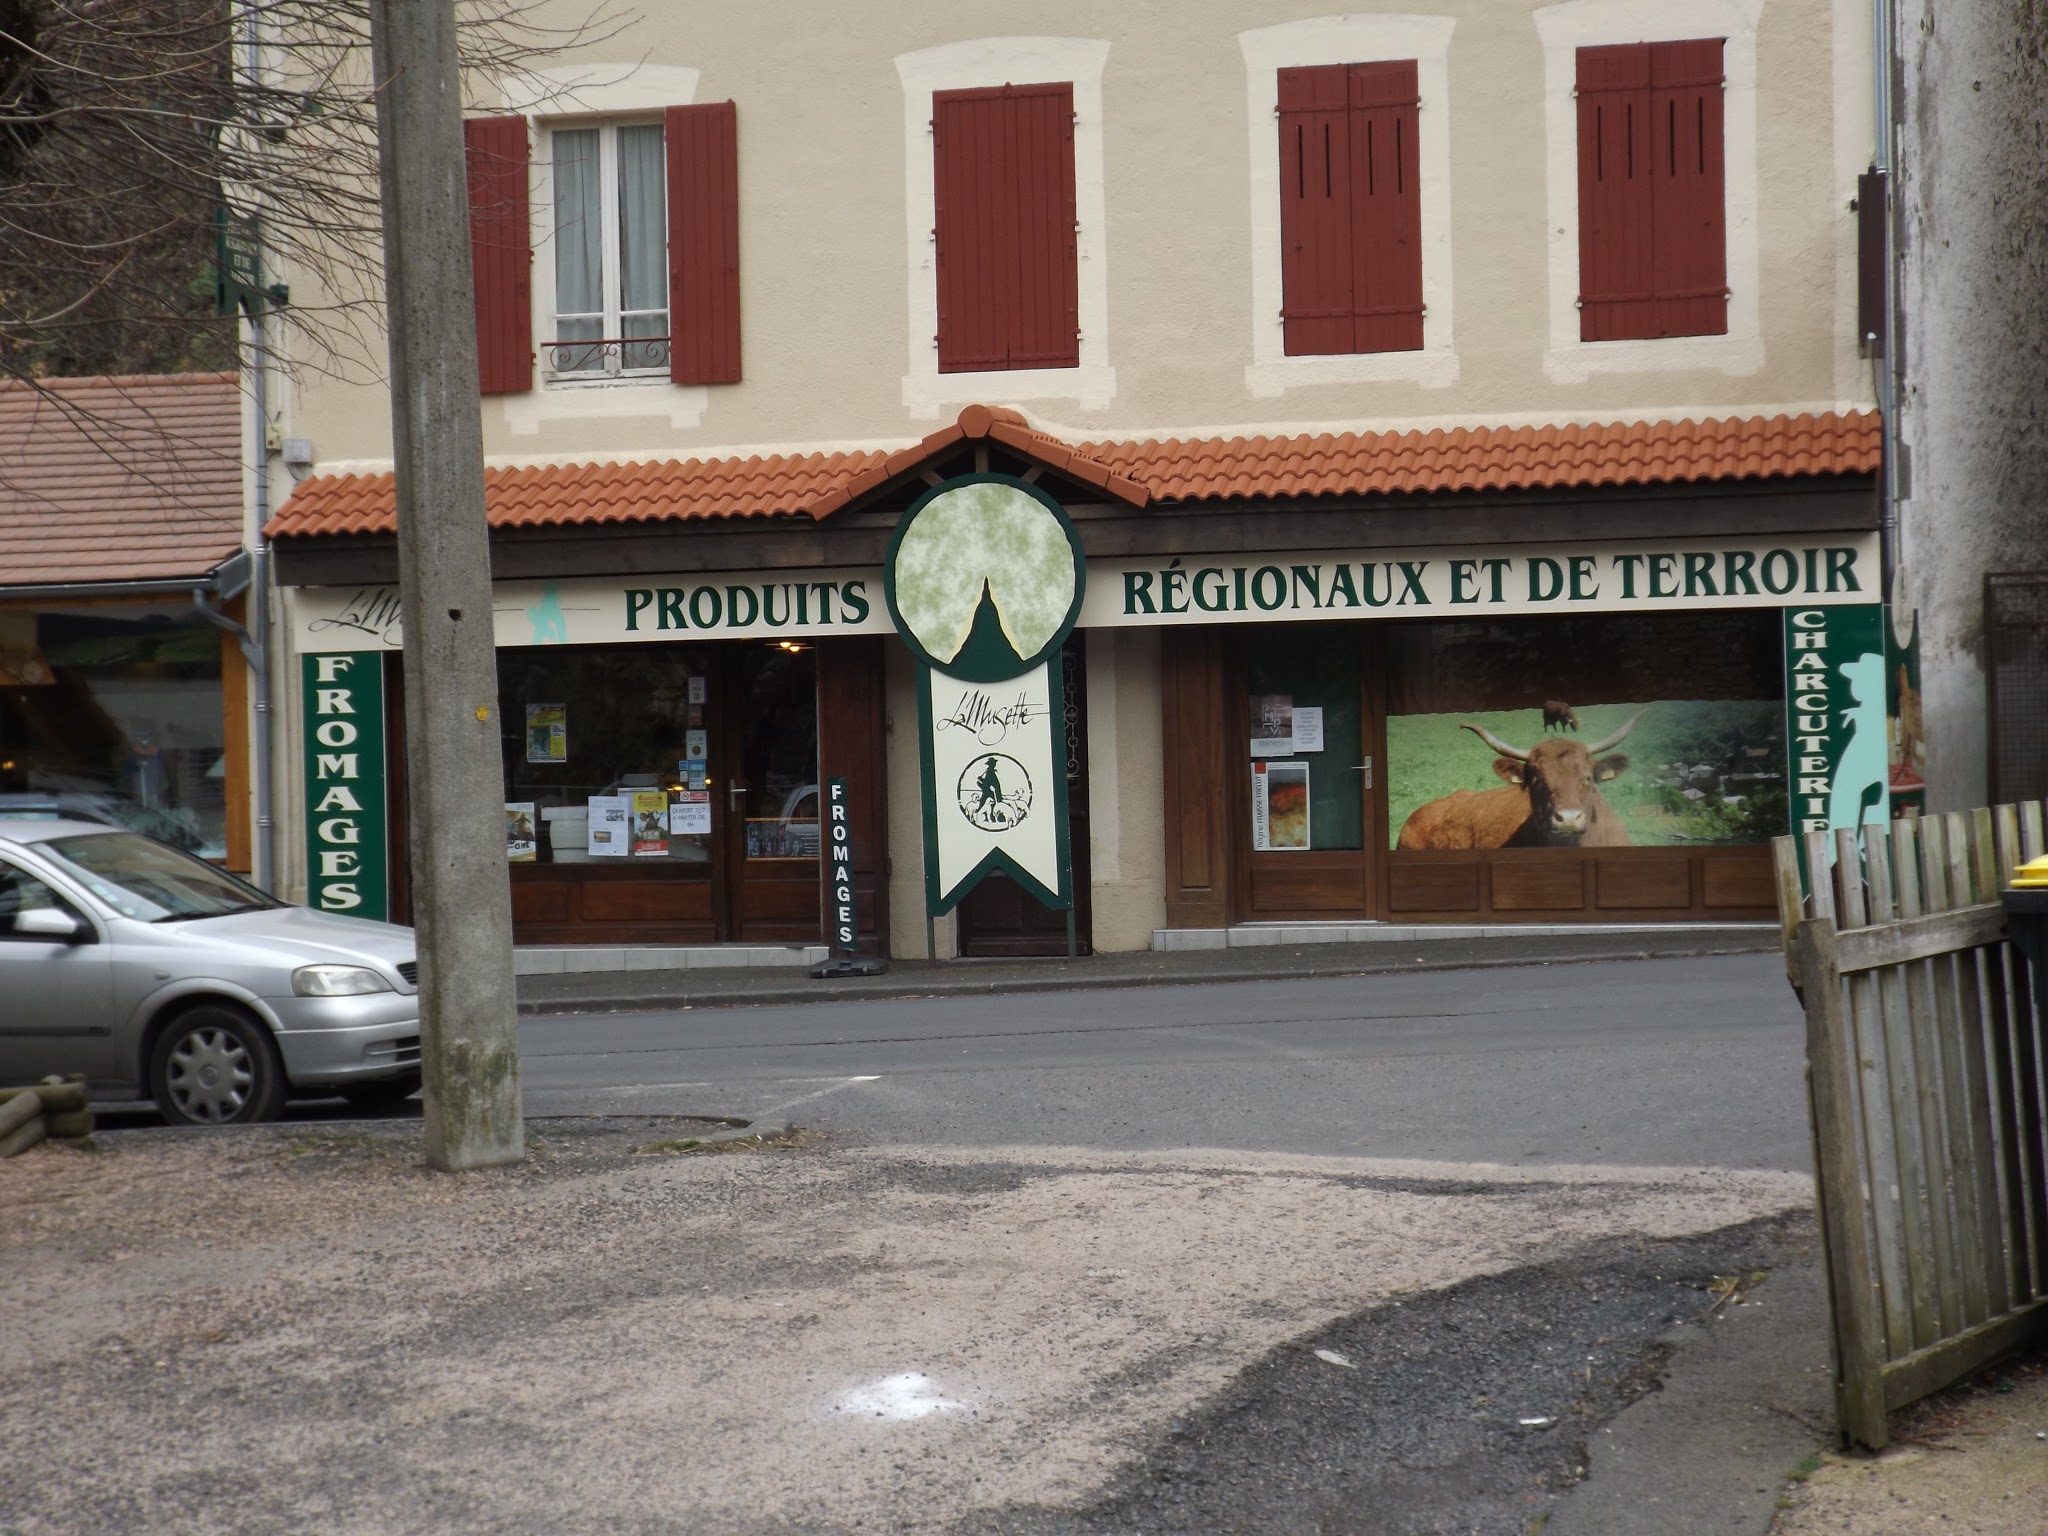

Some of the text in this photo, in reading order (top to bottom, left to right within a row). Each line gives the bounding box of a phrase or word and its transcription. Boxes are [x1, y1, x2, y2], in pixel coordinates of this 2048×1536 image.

[624, 547, 1862, 631] PRODUITS RÉGIONAUX ET DE TERROIR
[315, 657, 363, 909] FROMAGES
[1793, 611, 1831, 832] CHARCUTERIE
[831, 785, 853, 942] FROMAGES
